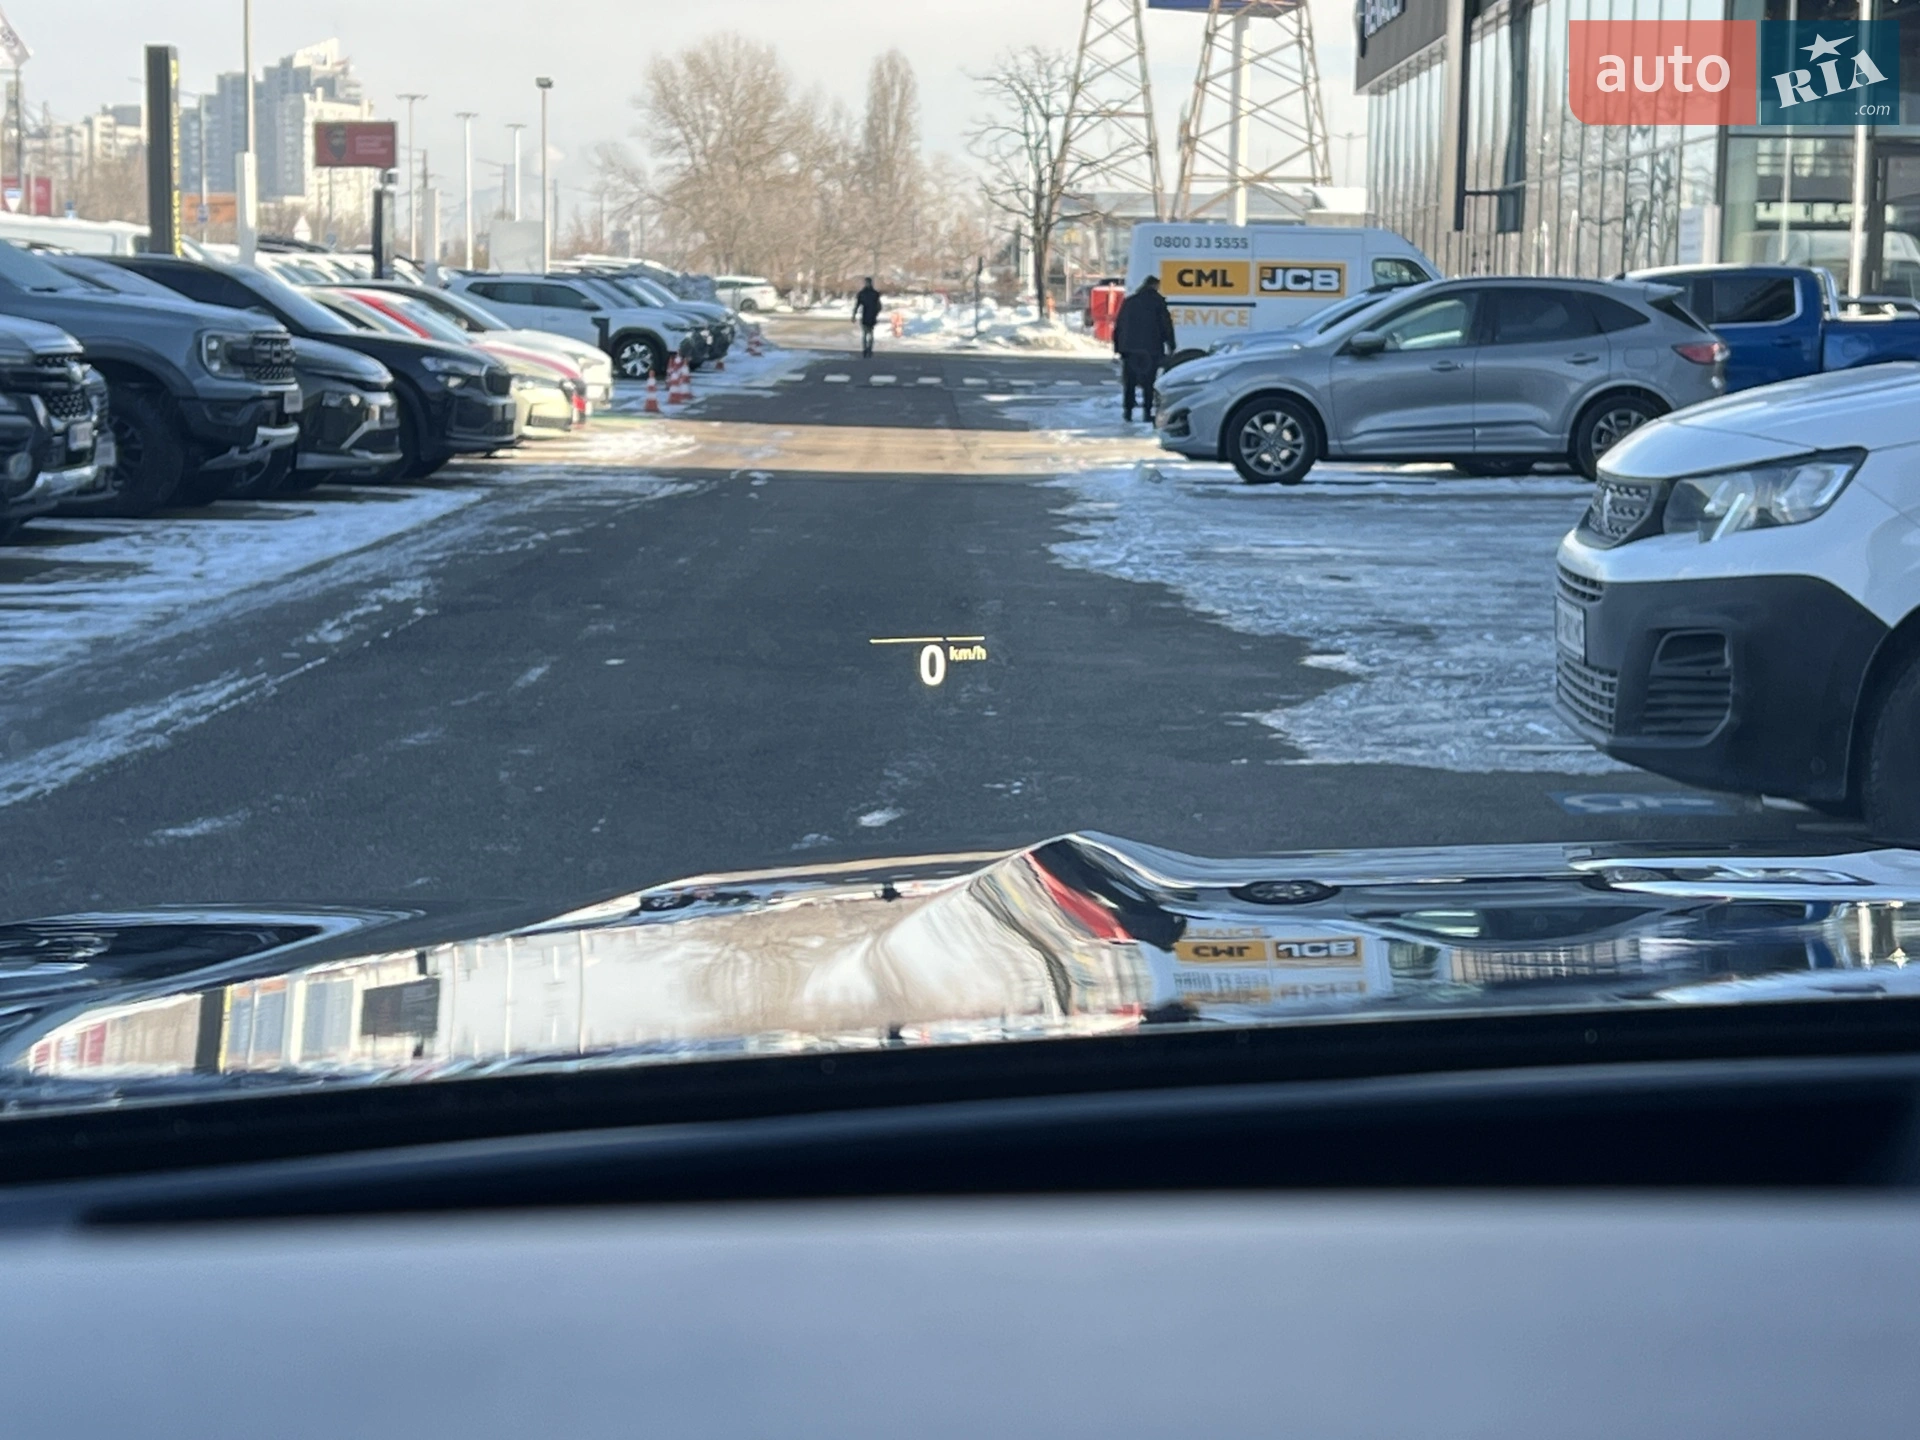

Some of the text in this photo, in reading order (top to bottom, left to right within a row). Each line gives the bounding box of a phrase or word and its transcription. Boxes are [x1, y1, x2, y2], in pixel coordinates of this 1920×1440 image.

[1153, 236, 1191, 248] 0800
[1214, 237, 1249, 249] 5555
[1177, 268, 1234, 287] CML
[1261, 268, 1340, 292] JCB
[1171, 309, 1249, 327] ERVICE
[920, 644, 987, 686] 0 km/h
